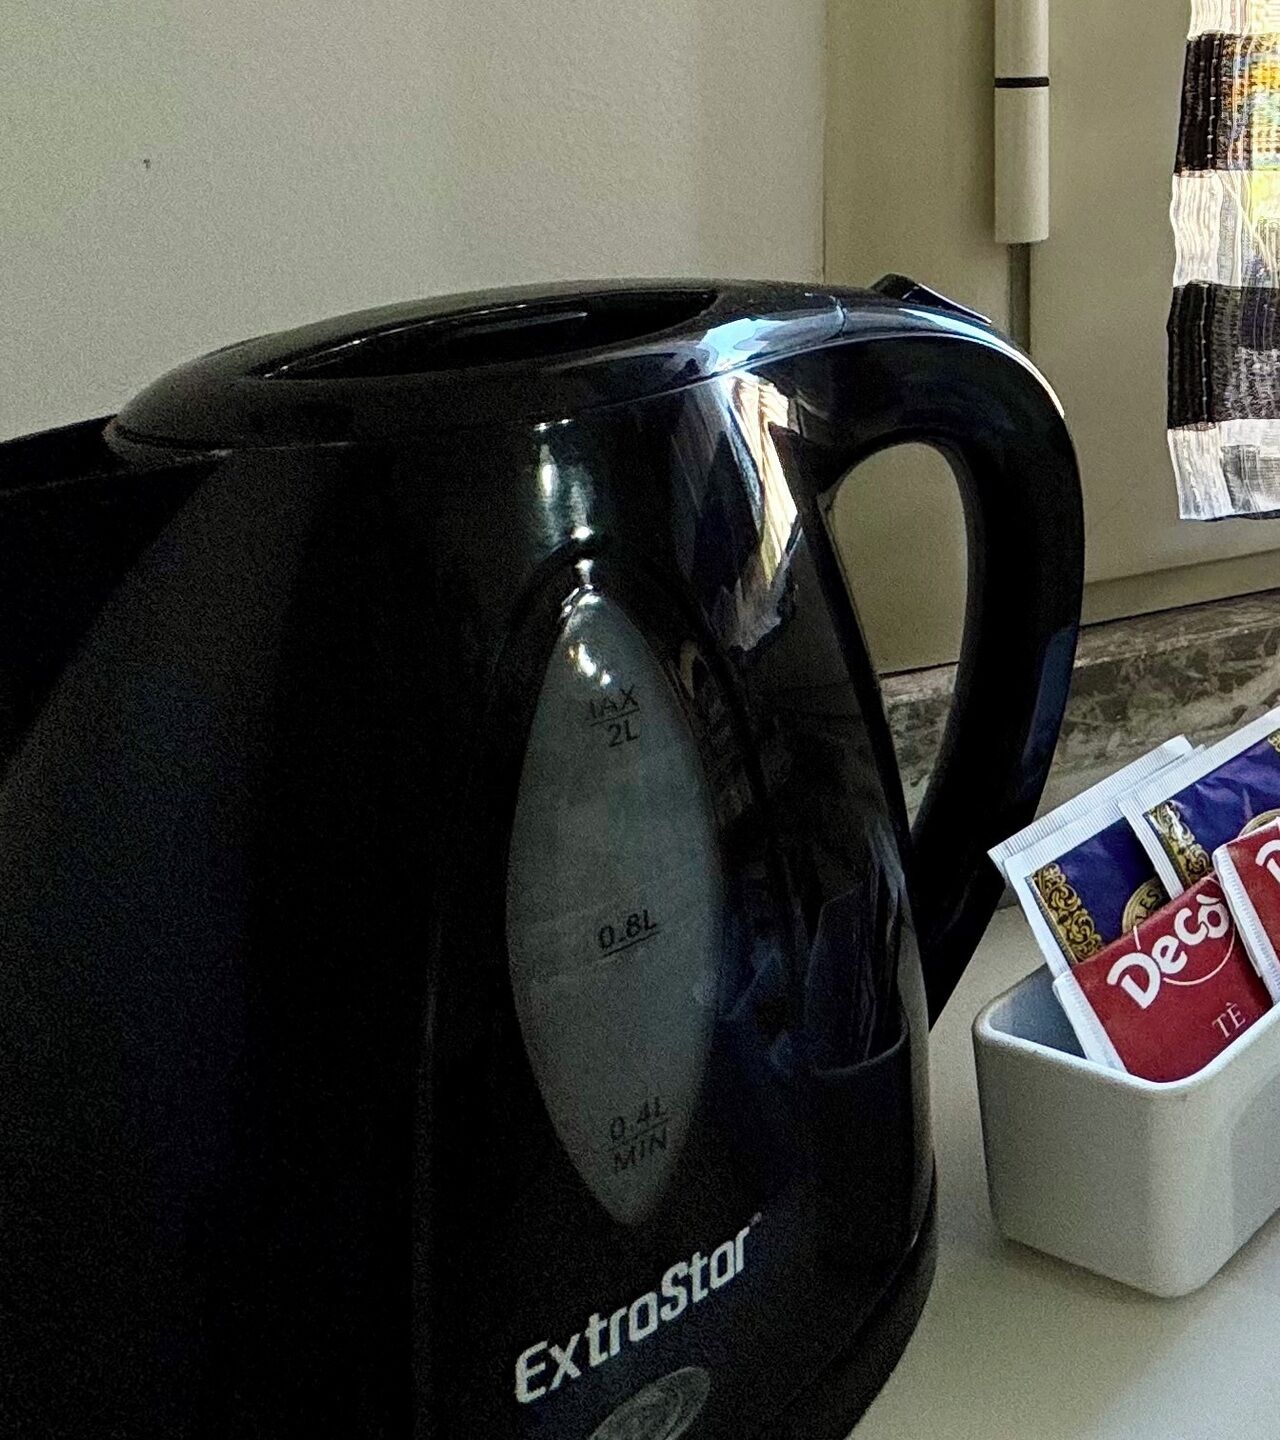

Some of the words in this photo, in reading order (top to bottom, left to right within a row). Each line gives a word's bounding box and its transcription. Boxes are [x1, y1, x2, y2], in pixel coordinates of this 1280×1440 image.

[607, 720, 640, 748] 2L
[599, 909, 658, 951] 0.8L
[1211, 1001, 1246, 1039] TÈ
[613, 1127, 668, 1175] MIN
